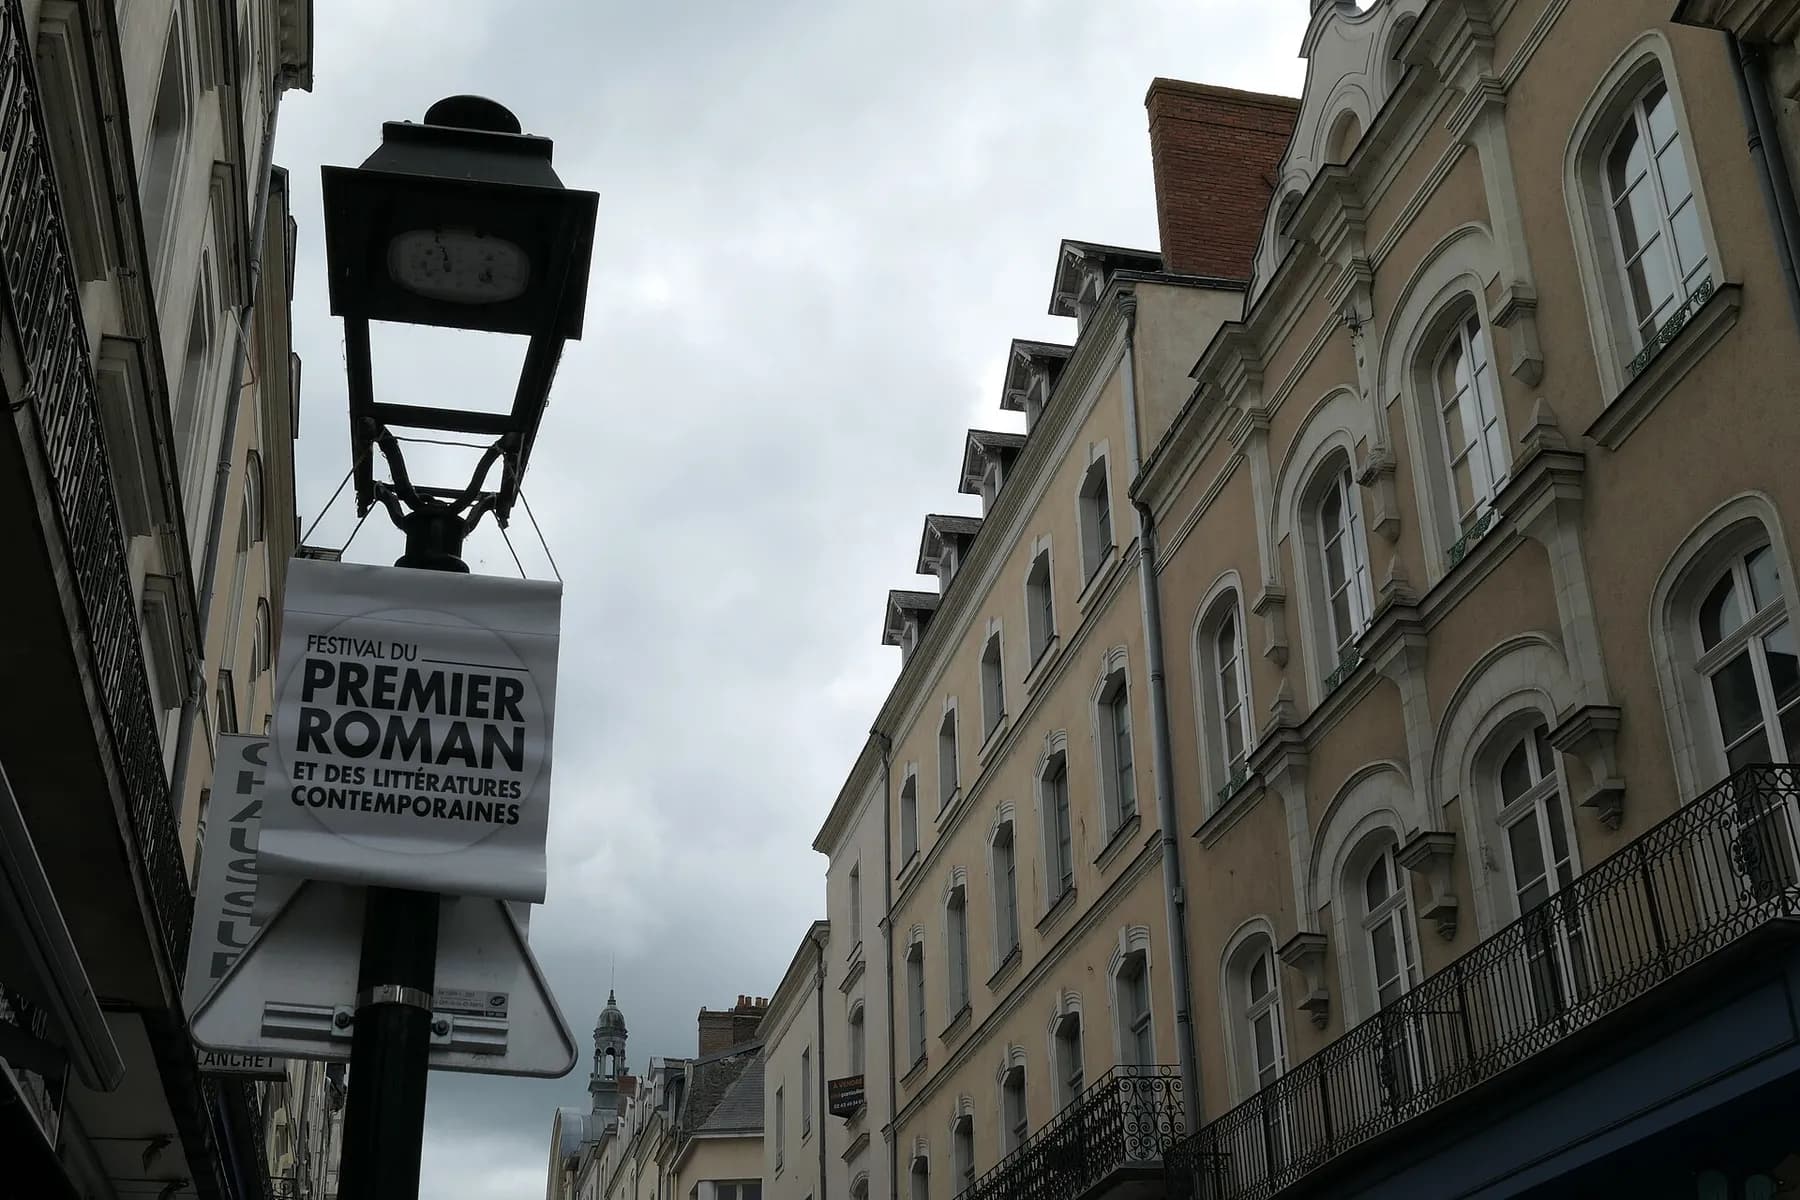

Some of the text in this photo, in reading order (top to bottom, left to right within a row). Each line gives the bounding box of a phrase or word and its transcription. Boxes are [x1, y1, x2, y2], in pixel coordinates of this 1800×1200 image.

[307, 634, 417, 662] FESTIVAL DU
[301, 658, 526, 723] PREMIER
[296, 707, 526, 773] ROMAN
[293, 761, 521, 799] ET DES LITTÉRATURES
[291, 785, 519, 825] CONTEMPORAINES
